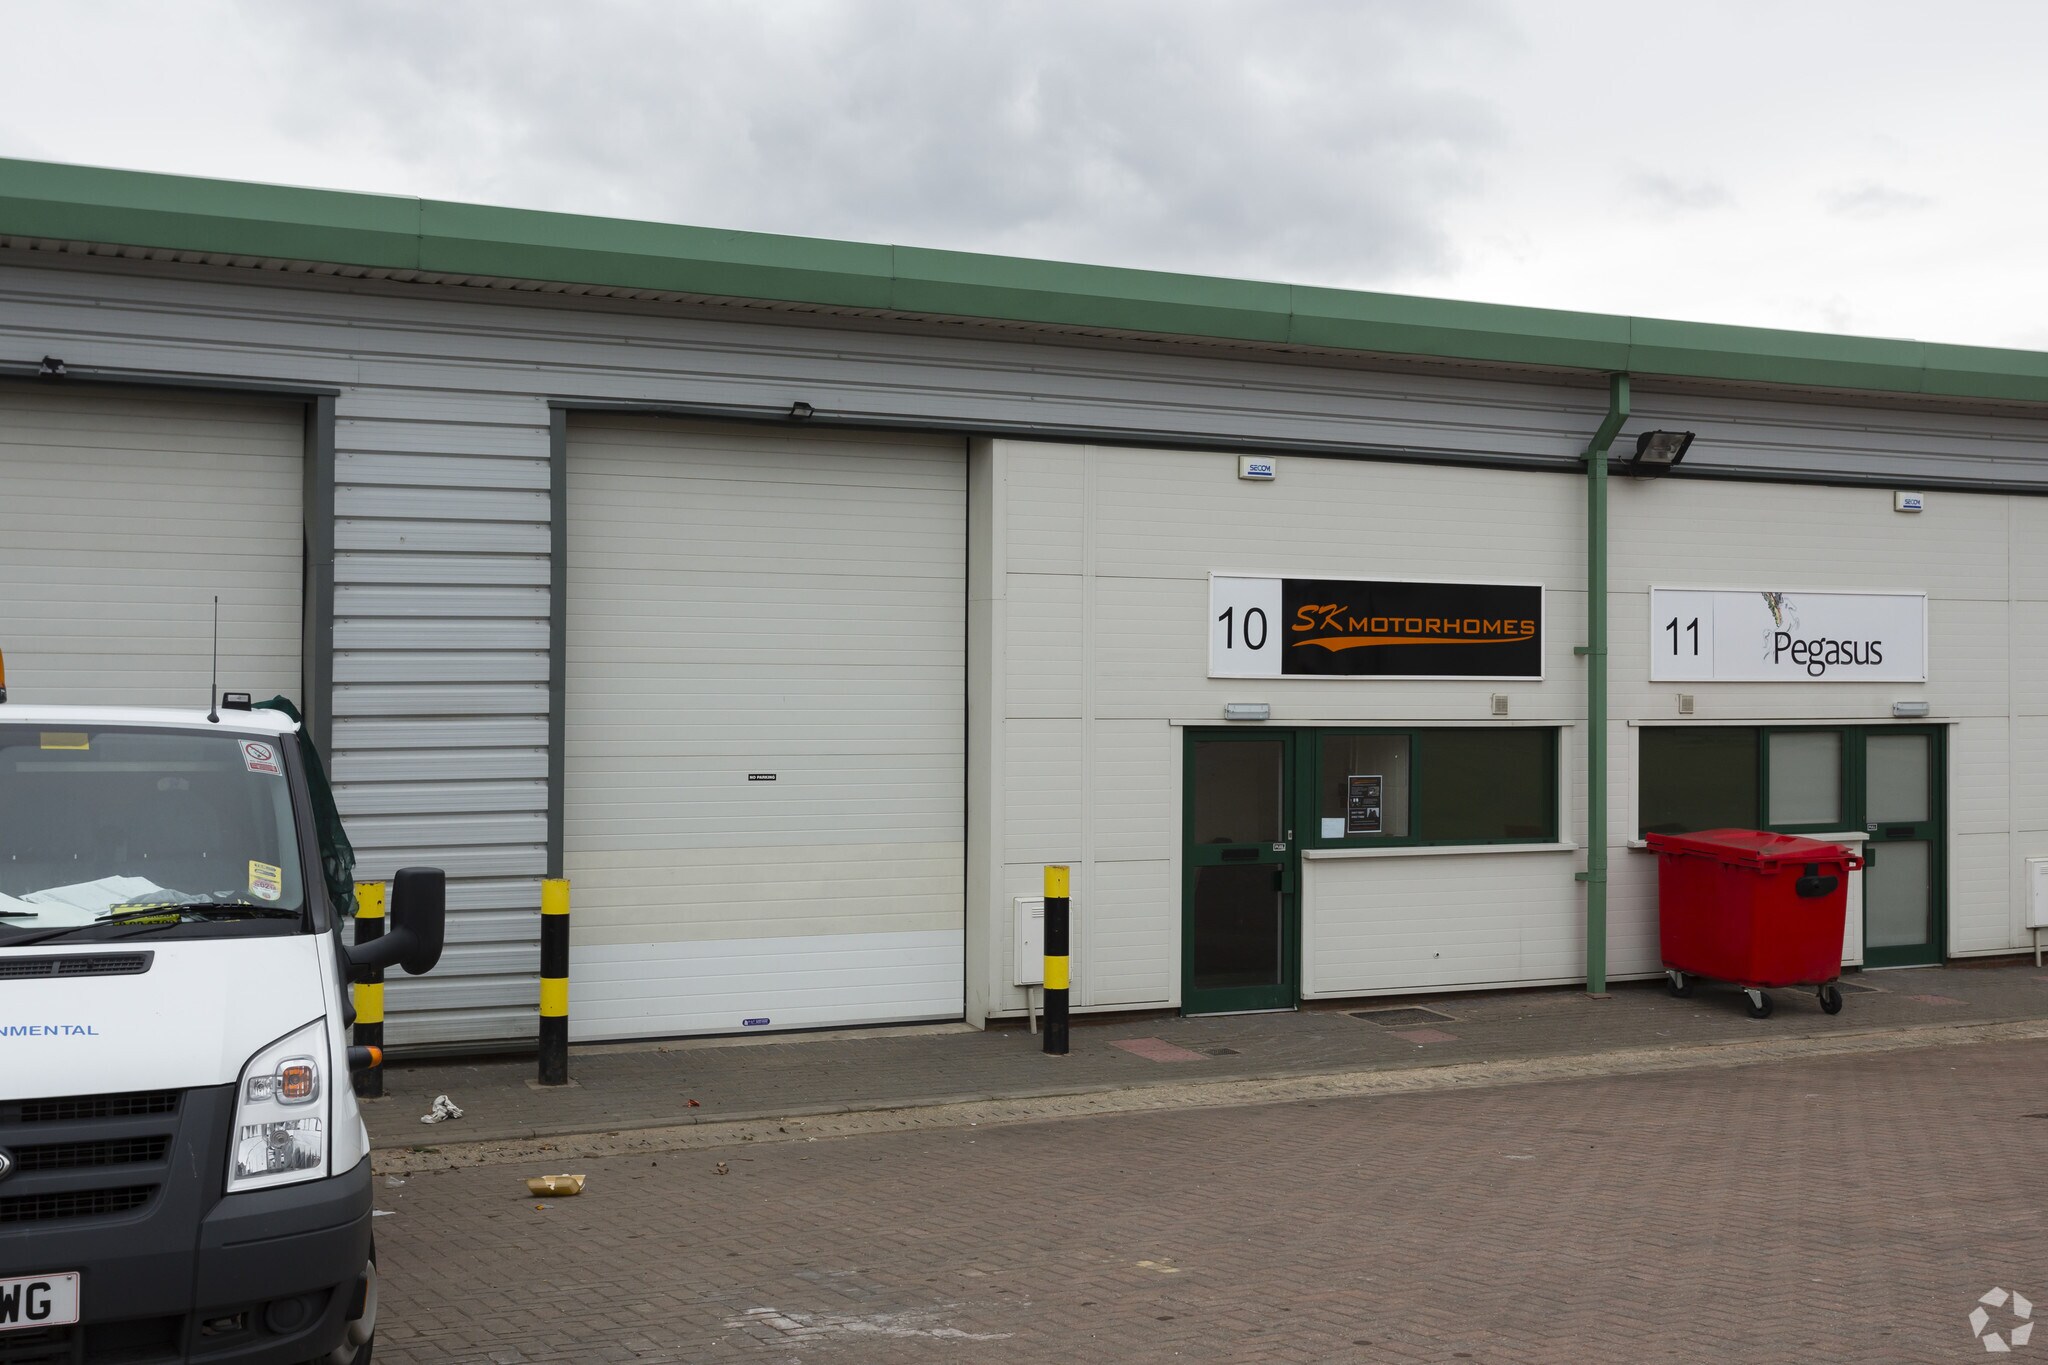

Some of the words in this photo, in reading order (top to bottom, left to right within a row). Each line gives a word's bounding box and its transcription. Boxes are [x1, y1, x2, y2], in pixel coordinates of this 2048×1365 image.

[1218, 606, 1268, 650] 10
[1292, 604, 1348, 632] SK
[1348, 616, 1535, 635] MOTORHOMES
[1666, 616, 1699, 656] 11
[1774, 632, 1882, 677] Pegasus
[0, 1282, 51, 1324] WG
